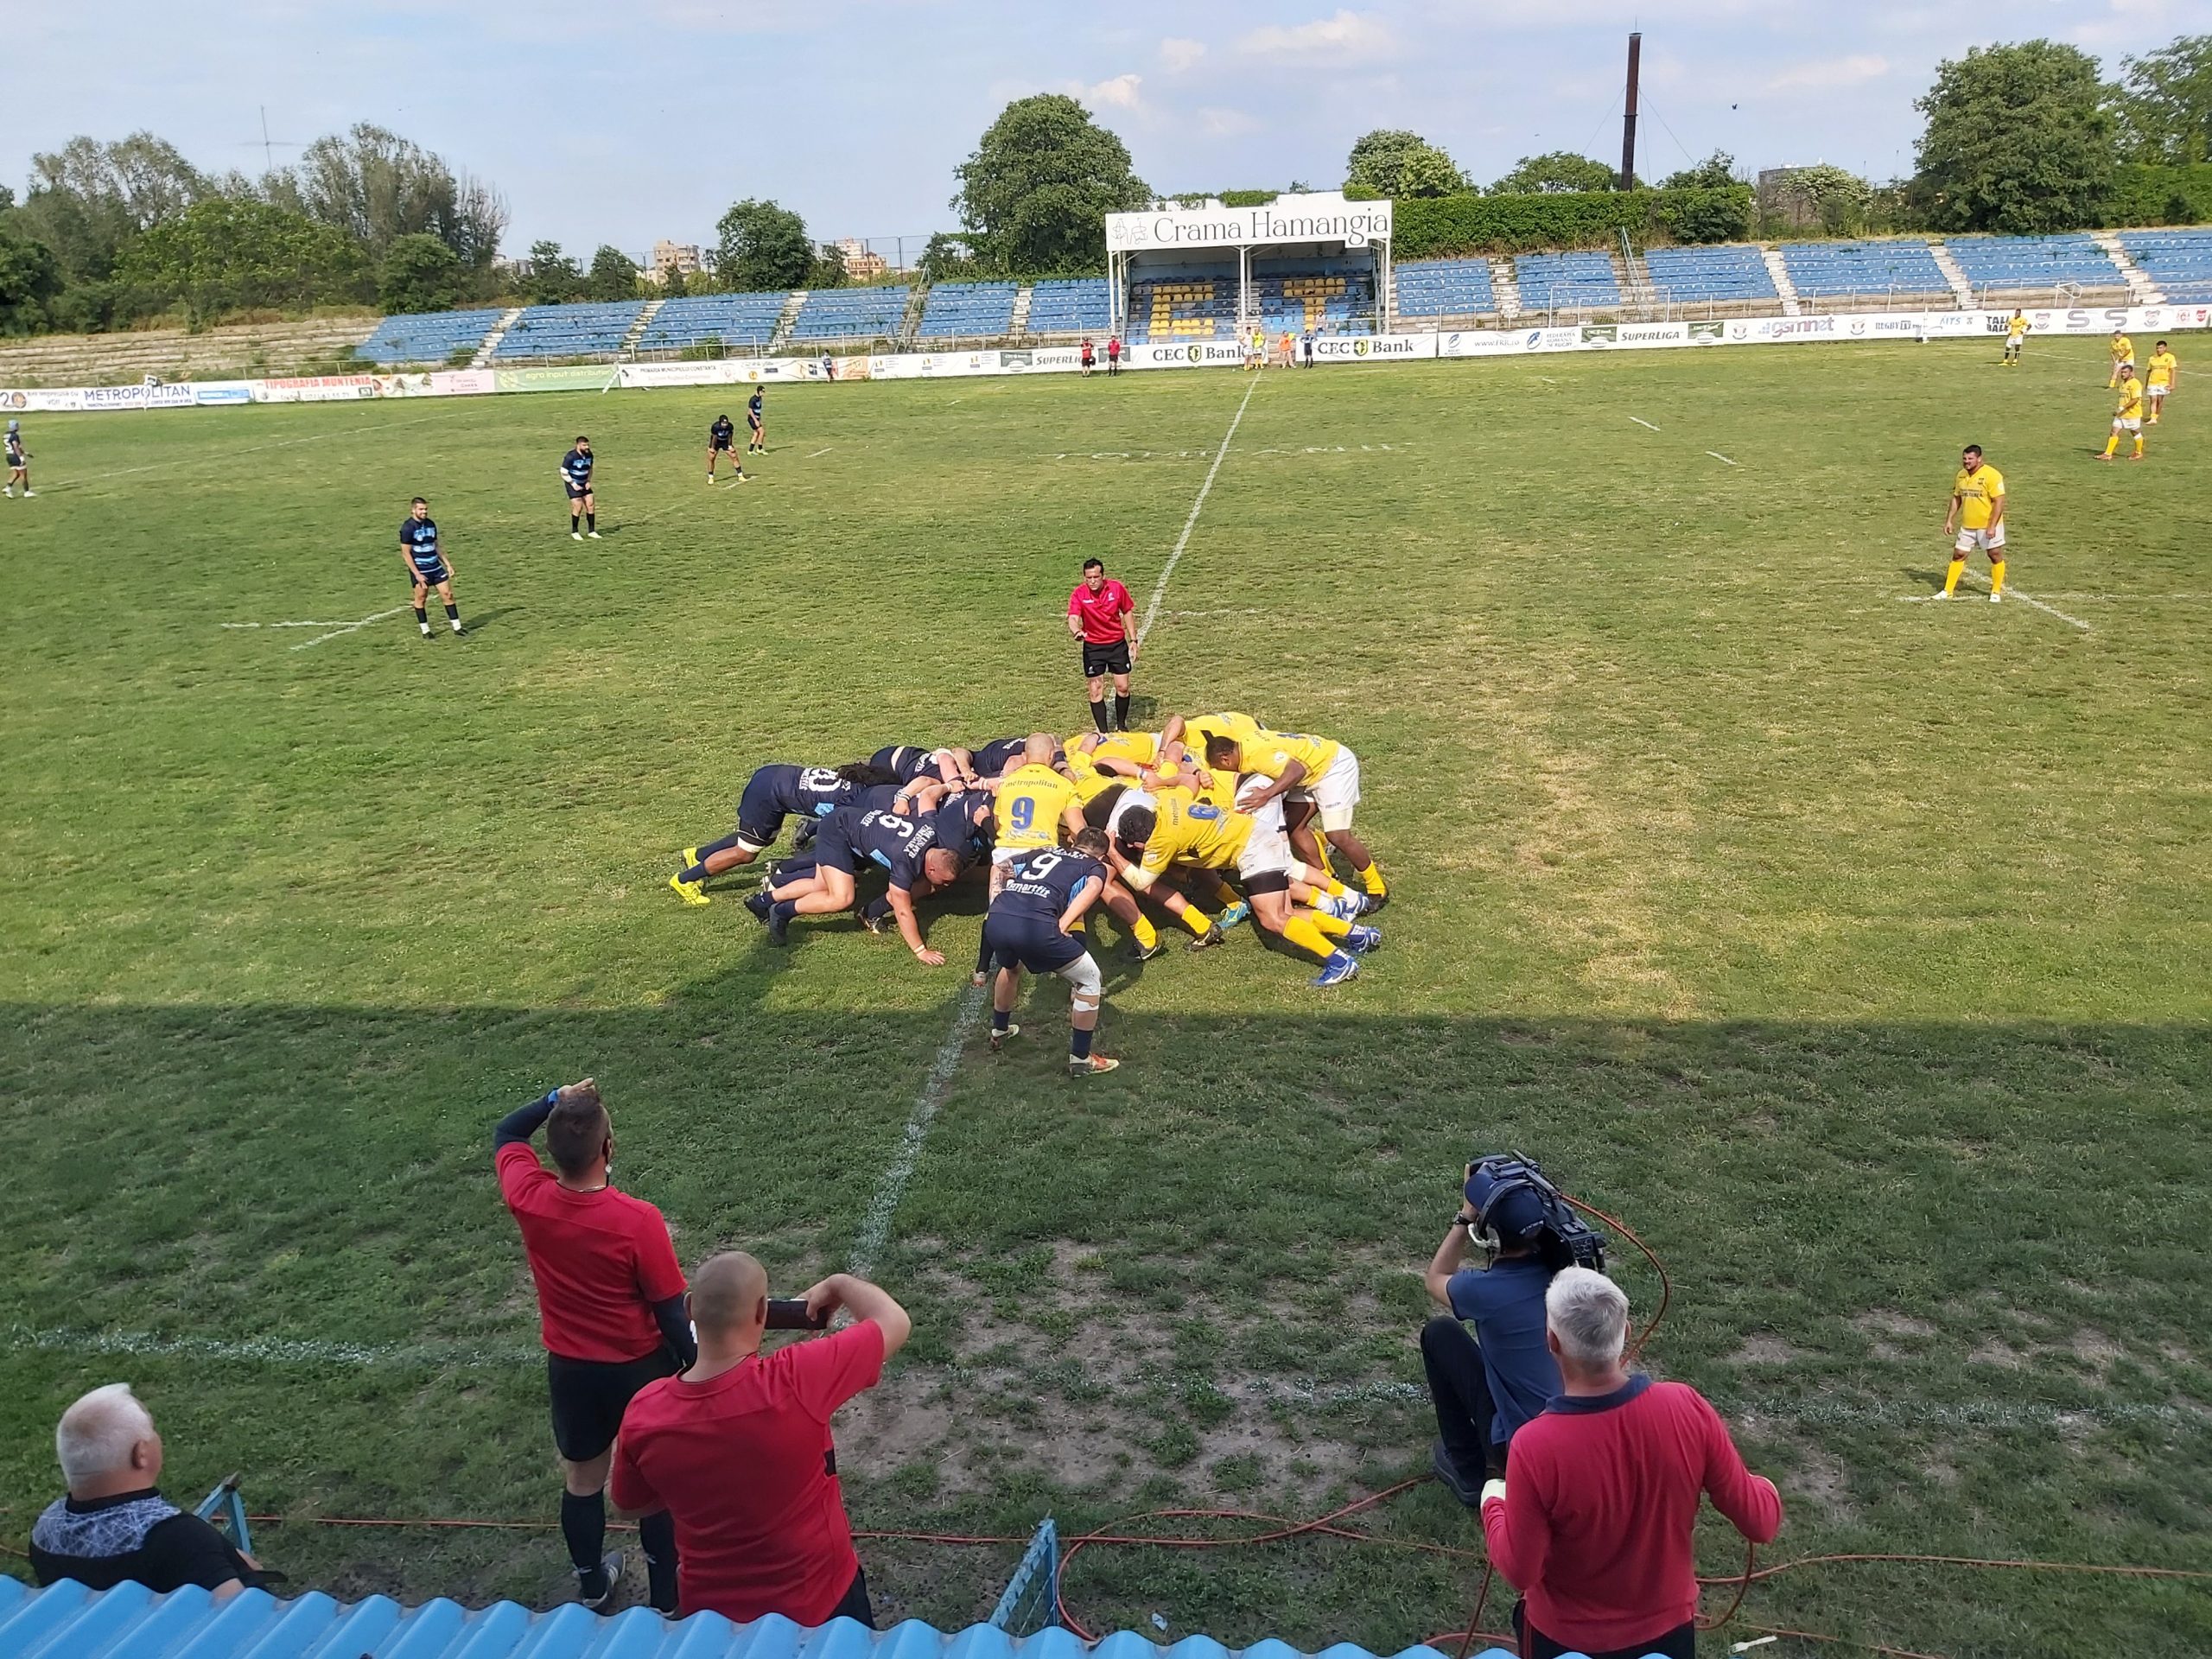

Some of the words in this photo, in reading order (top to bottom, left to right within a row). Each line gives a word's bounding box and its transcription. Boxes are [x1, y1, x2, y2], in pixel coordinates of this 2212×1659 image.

[1154, 217, 1242, 243] Crama
[1250, 207, 1389, 246] Hamangia
[1621, 331, 1681, 341] SUPERLIGA
[1153, 348, 1185, 361] CEC
[1205, 345, 1246, 359] Bank
[1318, 341, 1350, 354] CEC
[1372, 338, 1414, 353] Bank
[265, 378, 321, 390] TIPOGRAFIA
[84, 385, 191, 401] METROPOLITAN
[1005, 779, 1059, 790] metropolitan
[1010, 795, 1036, 830] 9
[1187, 804, 1221, 821] 6
[878, 813, 916, 838] 6
[1021, 852, 1064, 881] 9
